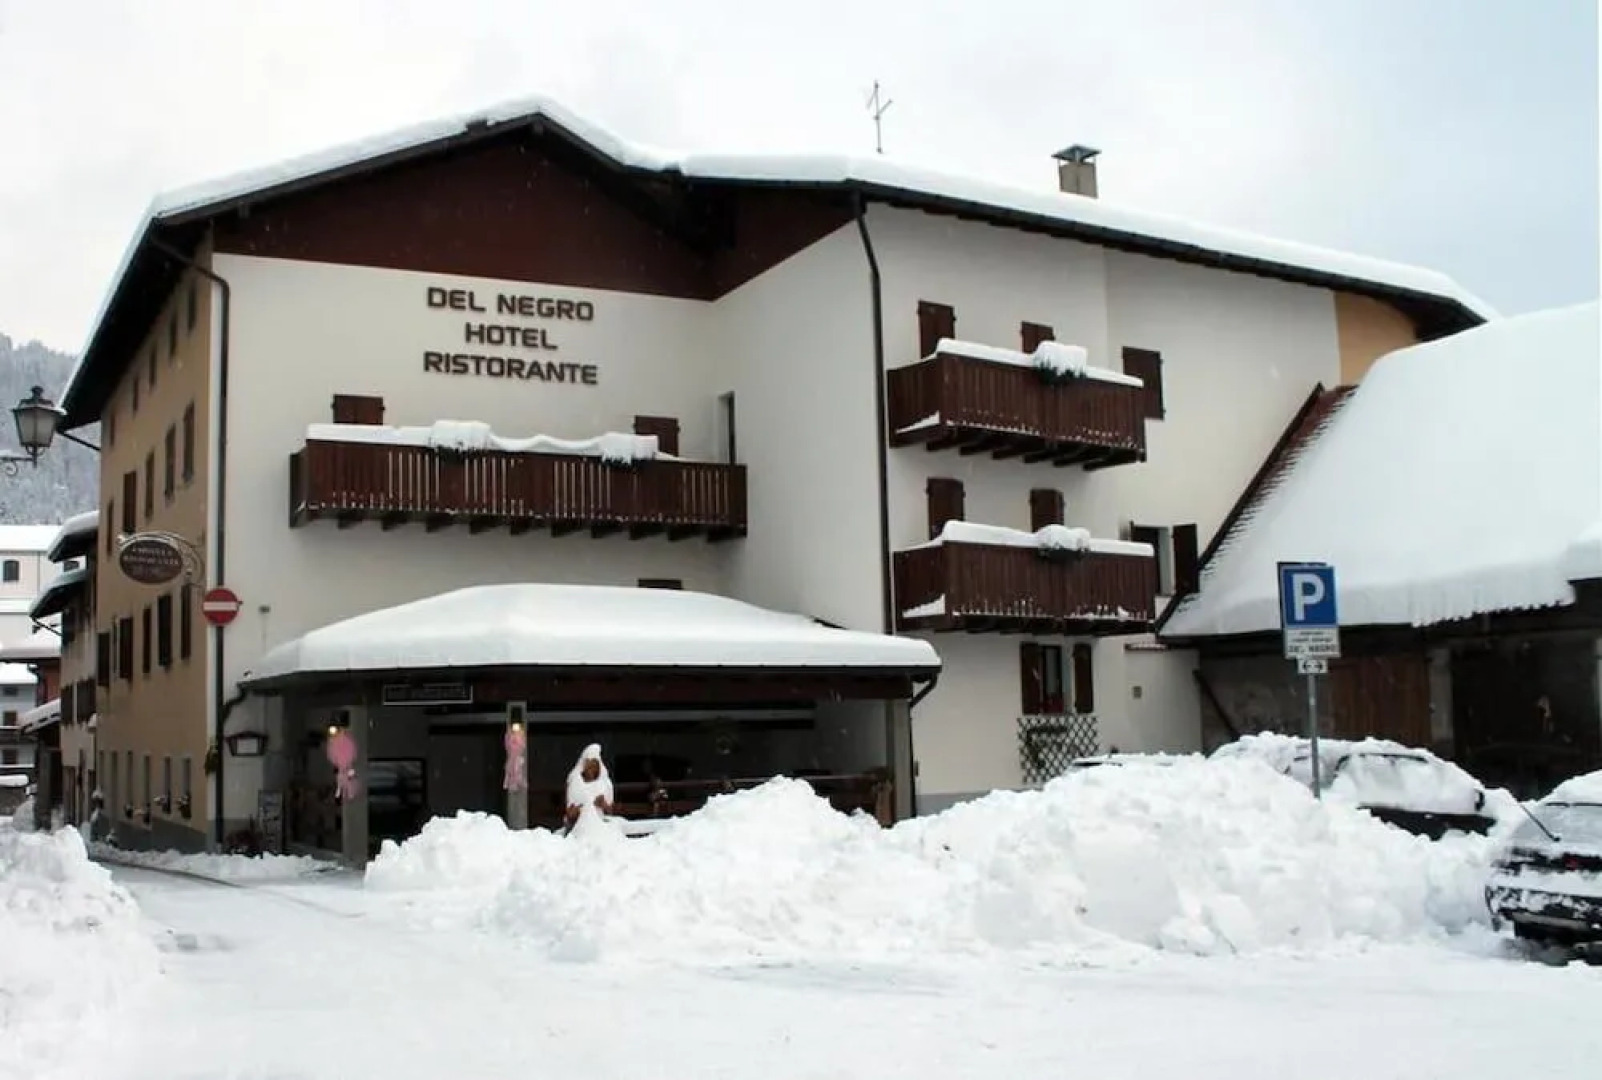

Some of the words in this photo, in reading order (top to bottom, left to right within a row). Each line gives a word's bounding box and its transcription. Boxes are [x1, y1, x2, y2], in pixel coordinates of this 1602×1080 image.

[427, 286, 486, 312] DEL
[497, 294, 594, 321] NEGRO
[465, 321, 558, 350] HOTEL
[423, 350, 598, 385] RISTORANTE
[1292, 573, 1325, 621] P
